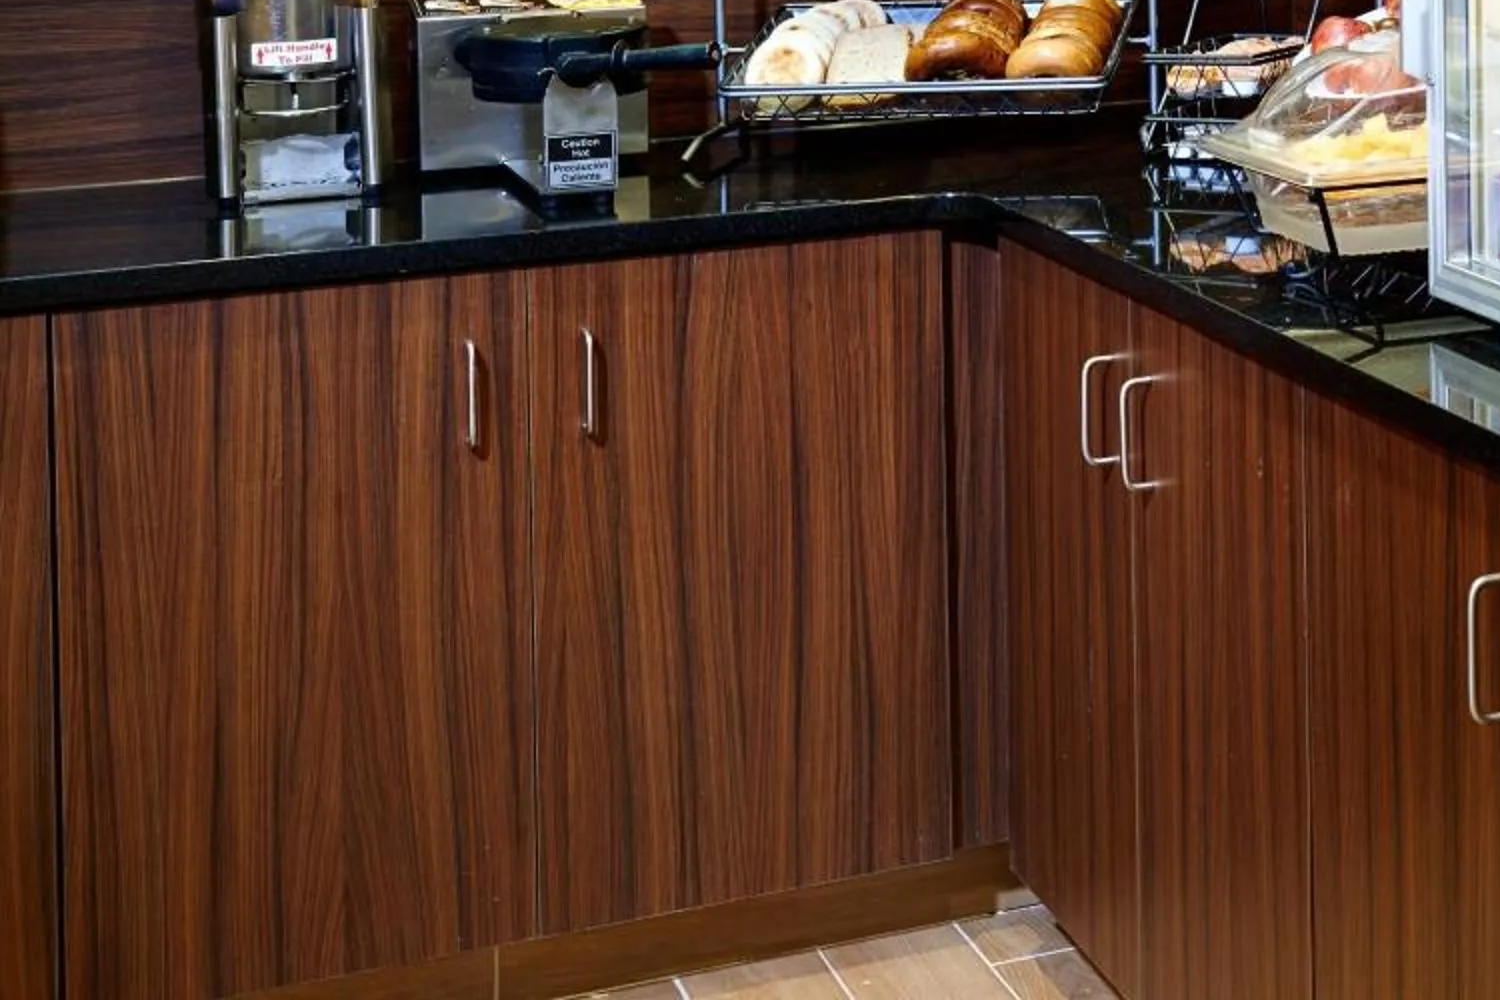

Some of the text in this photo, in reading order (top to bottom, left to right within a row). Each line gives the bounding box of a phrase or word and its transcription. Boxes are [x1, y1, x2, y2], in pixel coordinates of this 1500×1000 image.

[285, 42, 325, 53] Handle
[561, 138, 601, 149] Caution
[571, 149, 591, 157] Hot
